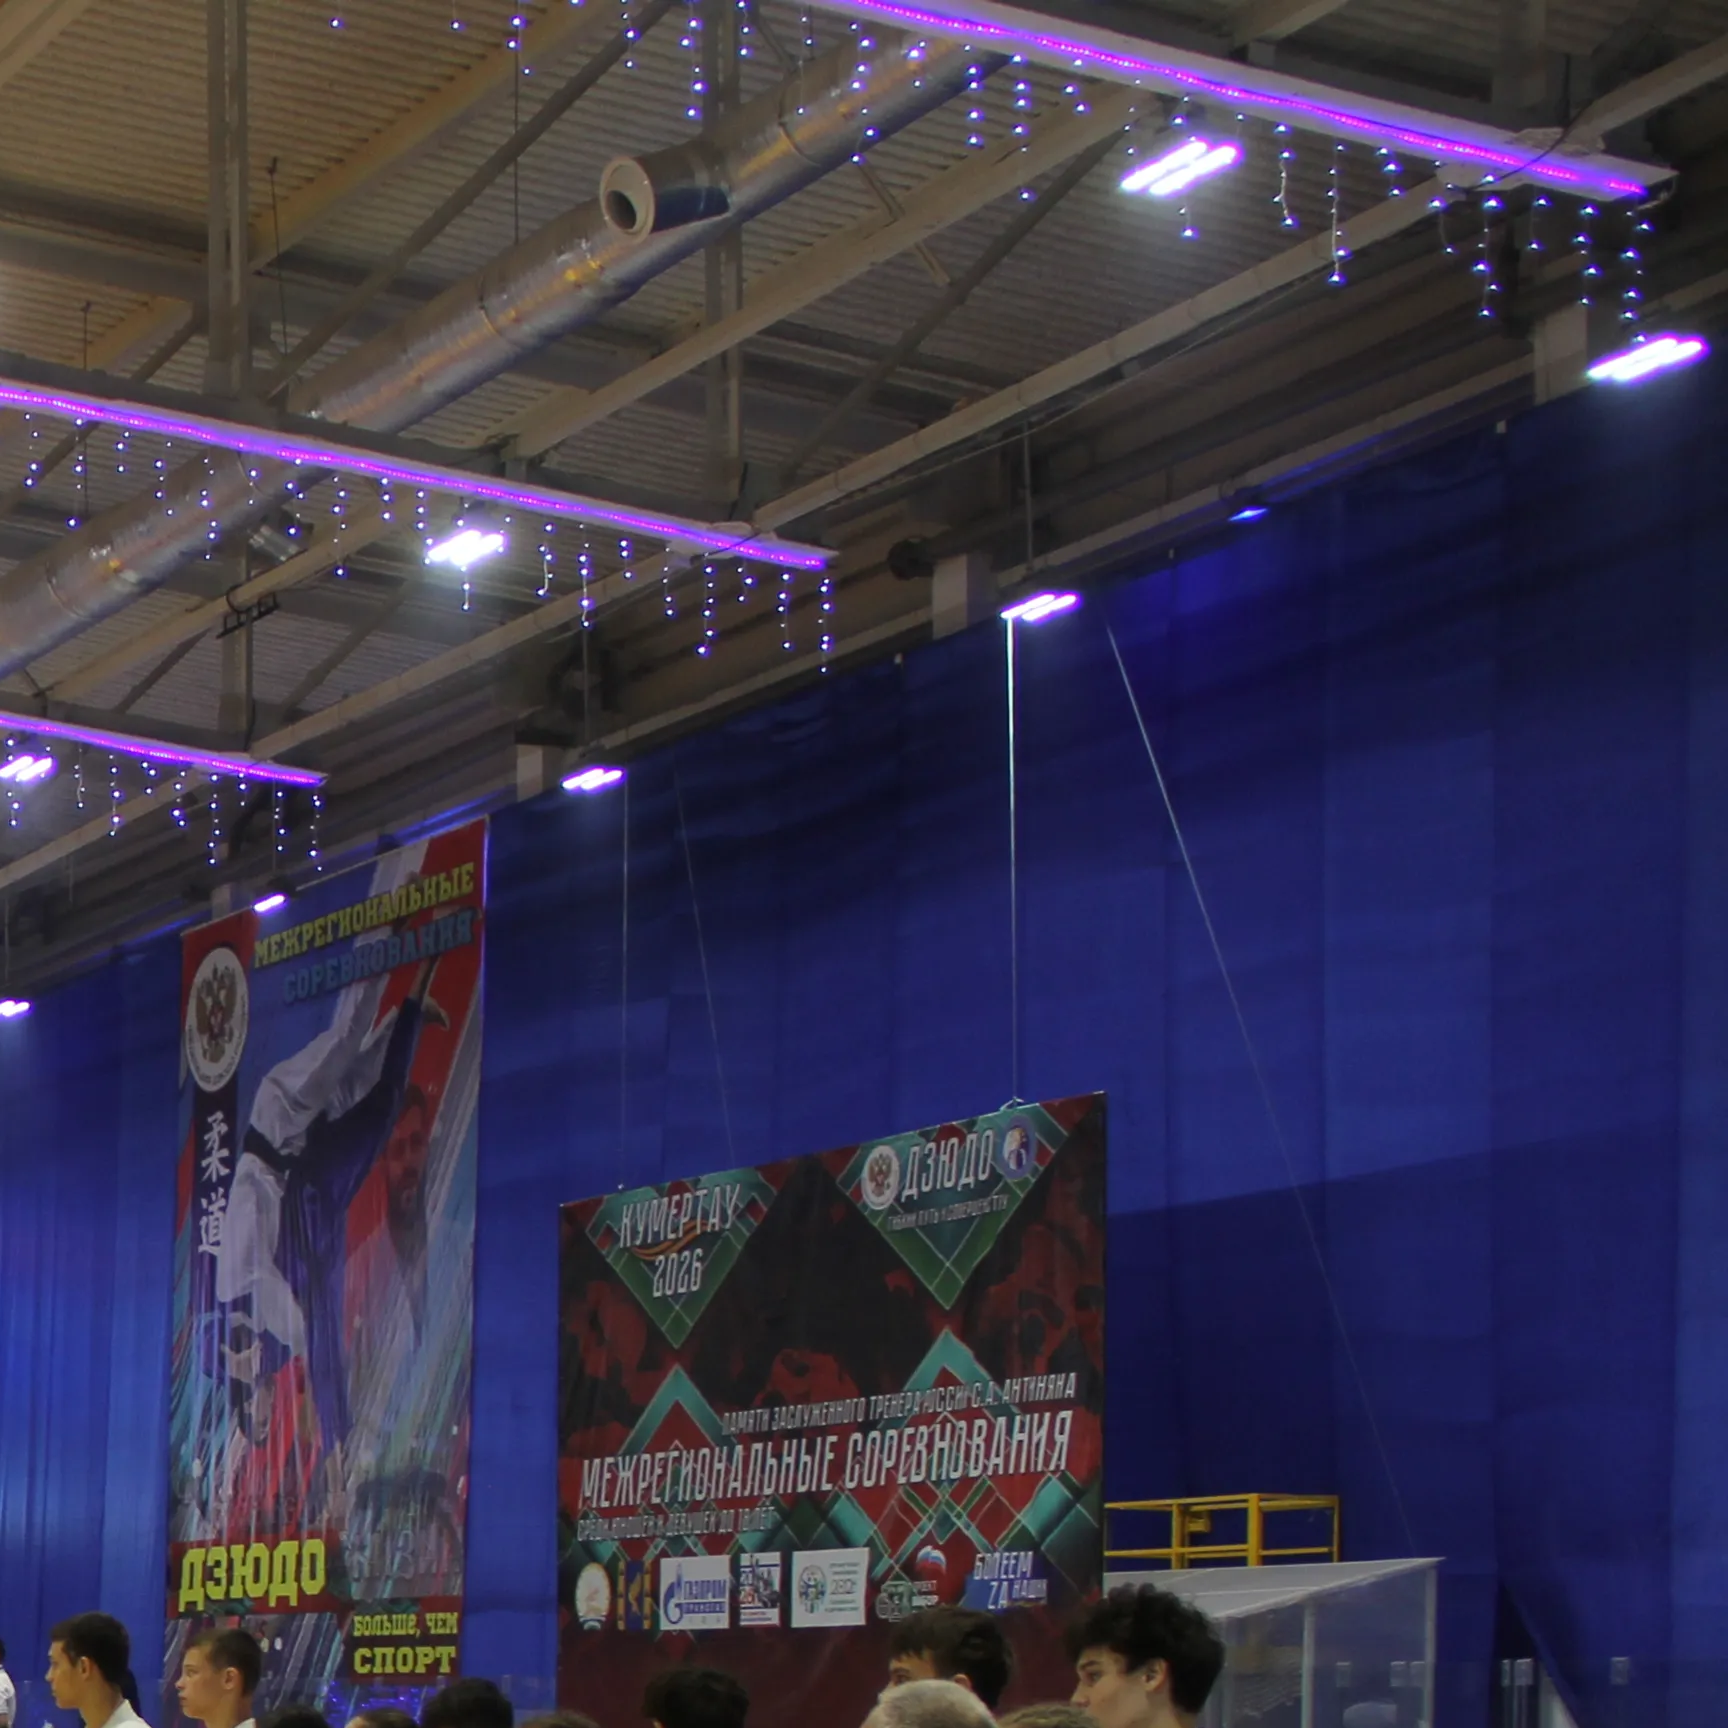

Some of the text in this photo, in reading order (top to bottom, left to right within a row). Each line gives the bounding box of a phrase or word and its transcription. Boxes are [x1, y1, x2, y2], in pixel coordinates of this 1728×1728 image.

[253, 862, 475, 968] МЕЖРЕГИОНАЛЬНЫЕ
[283, 909, 476, 1002] СОРЕВНОВАНИЯ
[901, 1129, 995, 1203] ДЗЮДО
[620, 1184, 740, 1248] КУМЕРТАУ
[653, 1248, 703, 1298] 2026
[722, 1408, 769, 1435] ПАМЯТИ
[771, 1398, 866, 1431] ЗАСЛУЖЕННОГО
[870, 1391, 920, 1420] ТРЕНЕРА
[578, 1410, 1073, 1509] МЕЖРЕГИОНАЛЬНЫЕ СОРЕВНОВАНИЯ
[178, 1539, 325, 1612] ДЗЮДО
[425, 1612, 458, 1635] ЧЕМ
[354, 1646, 456, 1674] СПОРТ
